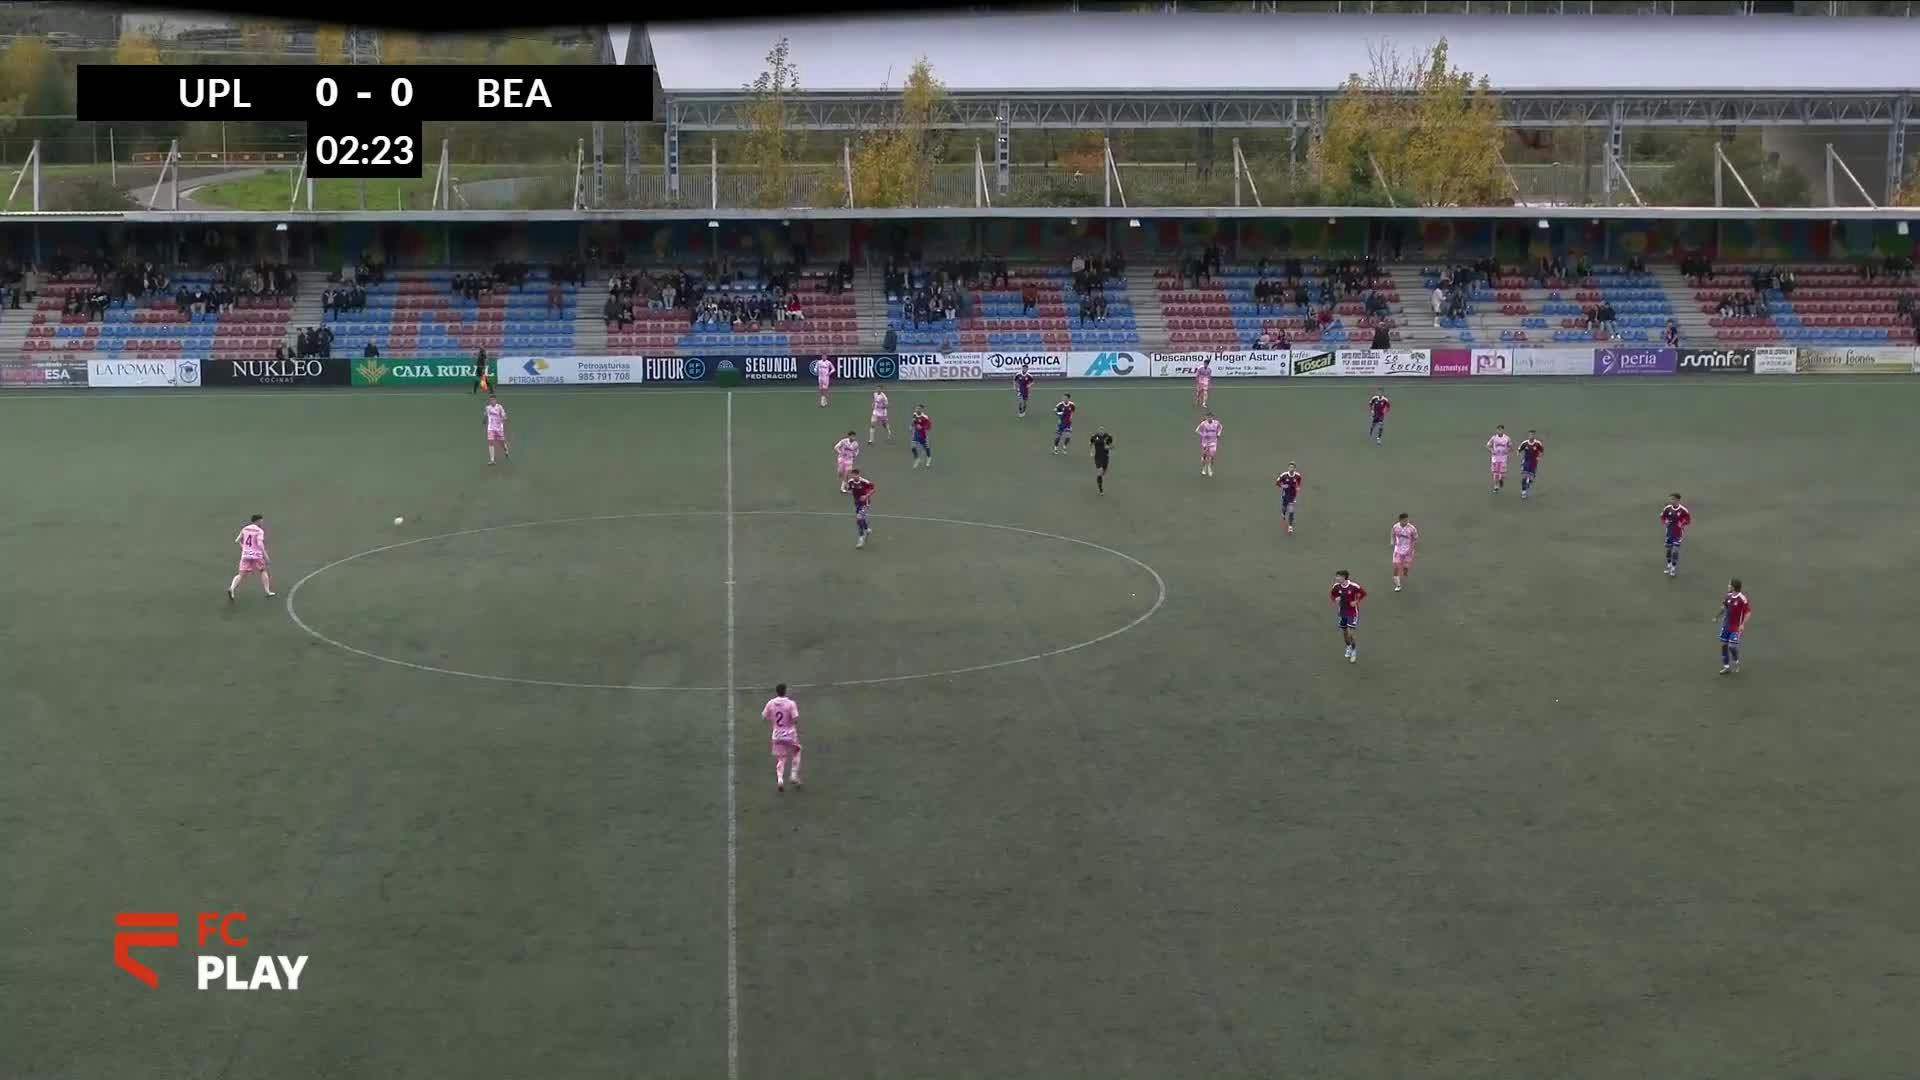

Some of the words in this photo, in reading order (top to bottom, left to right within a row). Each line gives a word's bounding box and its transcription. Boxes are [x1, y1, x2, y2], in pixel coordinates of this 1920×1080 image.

[899, 355, 940, 366] HOTEL
[1154, 354, 1203, 362] Descanso
[1215, 353, 1246, 363] Hogar
[1249, 353, 1278, 361] Astur
[1680, 351, 1750, 366] suminfor
[96, 364, 114, 376] LA
[118, 364, 166, 376] POMAR
[646, 358, 684, 380] FUTUR
[745, 358, 797, 372] SEGUNDA
[837, 357, 875, 379] FUTUR
[393, 366, 433, 378] CAJA
[245, 534, 253, 547] 4
[775, 711, 784, 727] 2
